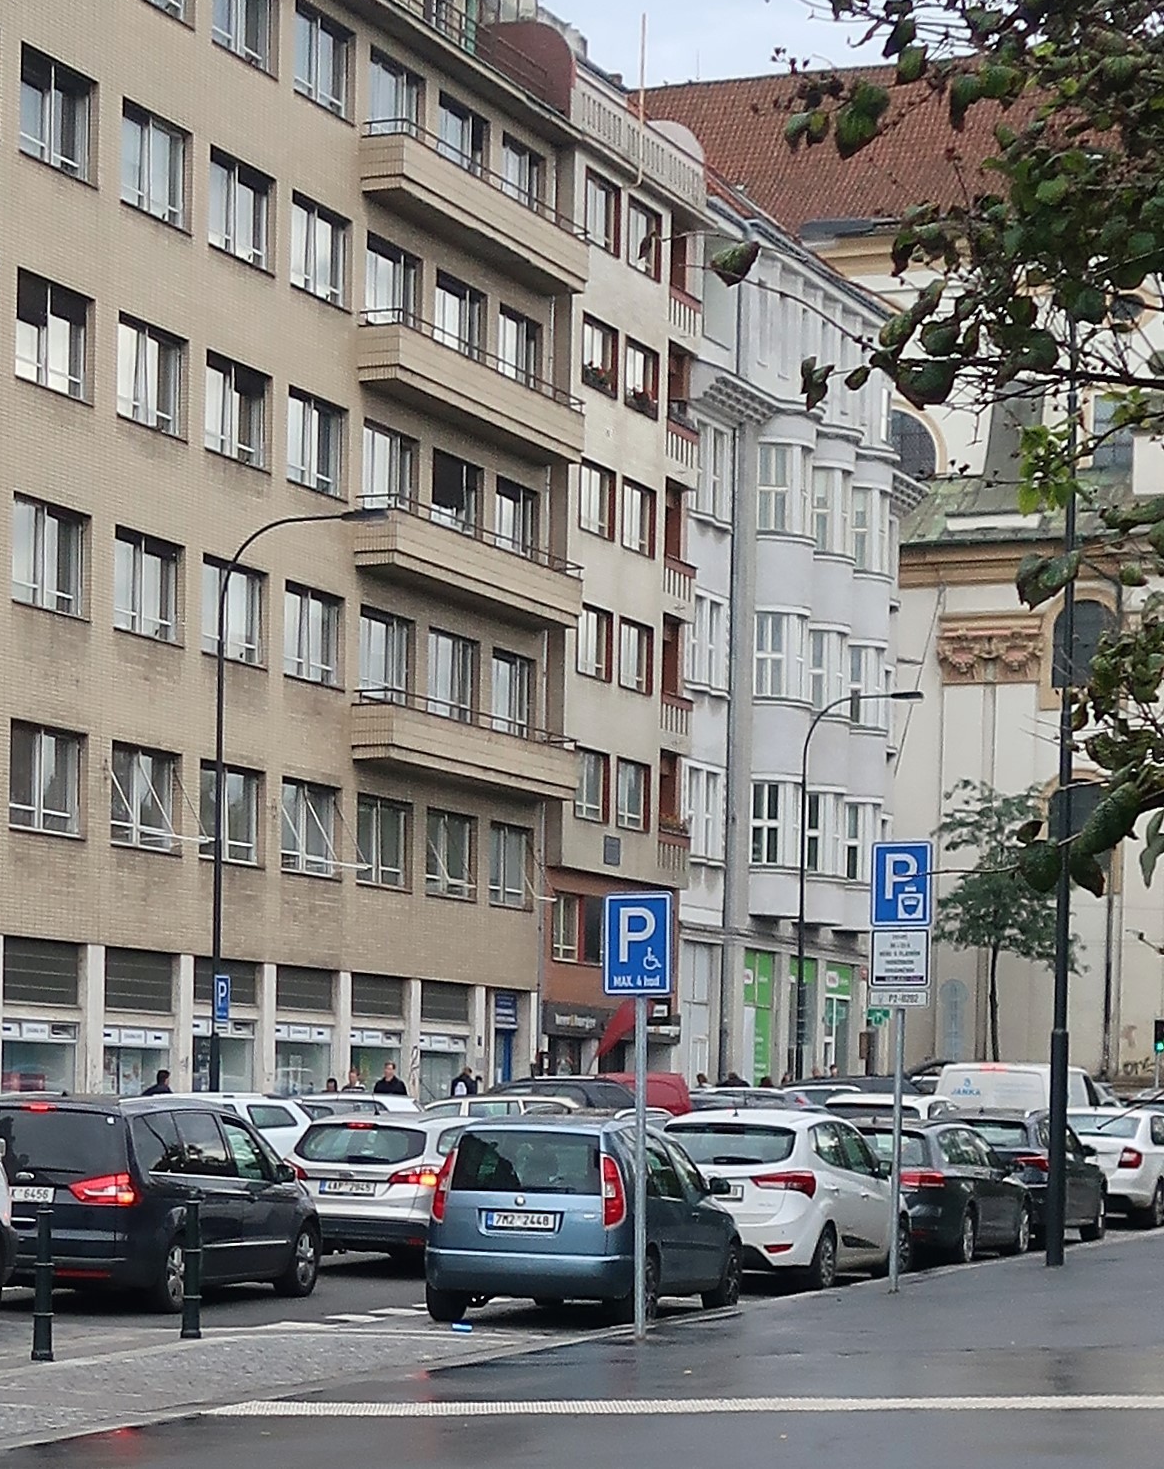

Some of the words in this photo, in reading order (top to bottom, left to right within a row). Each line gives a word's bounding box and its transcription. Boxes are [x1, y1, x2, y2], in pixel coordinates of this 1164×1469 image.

[885, 853, 917, 899] P
[619, 907, 655, 962] P
[218, 981, 227, 1007] P
